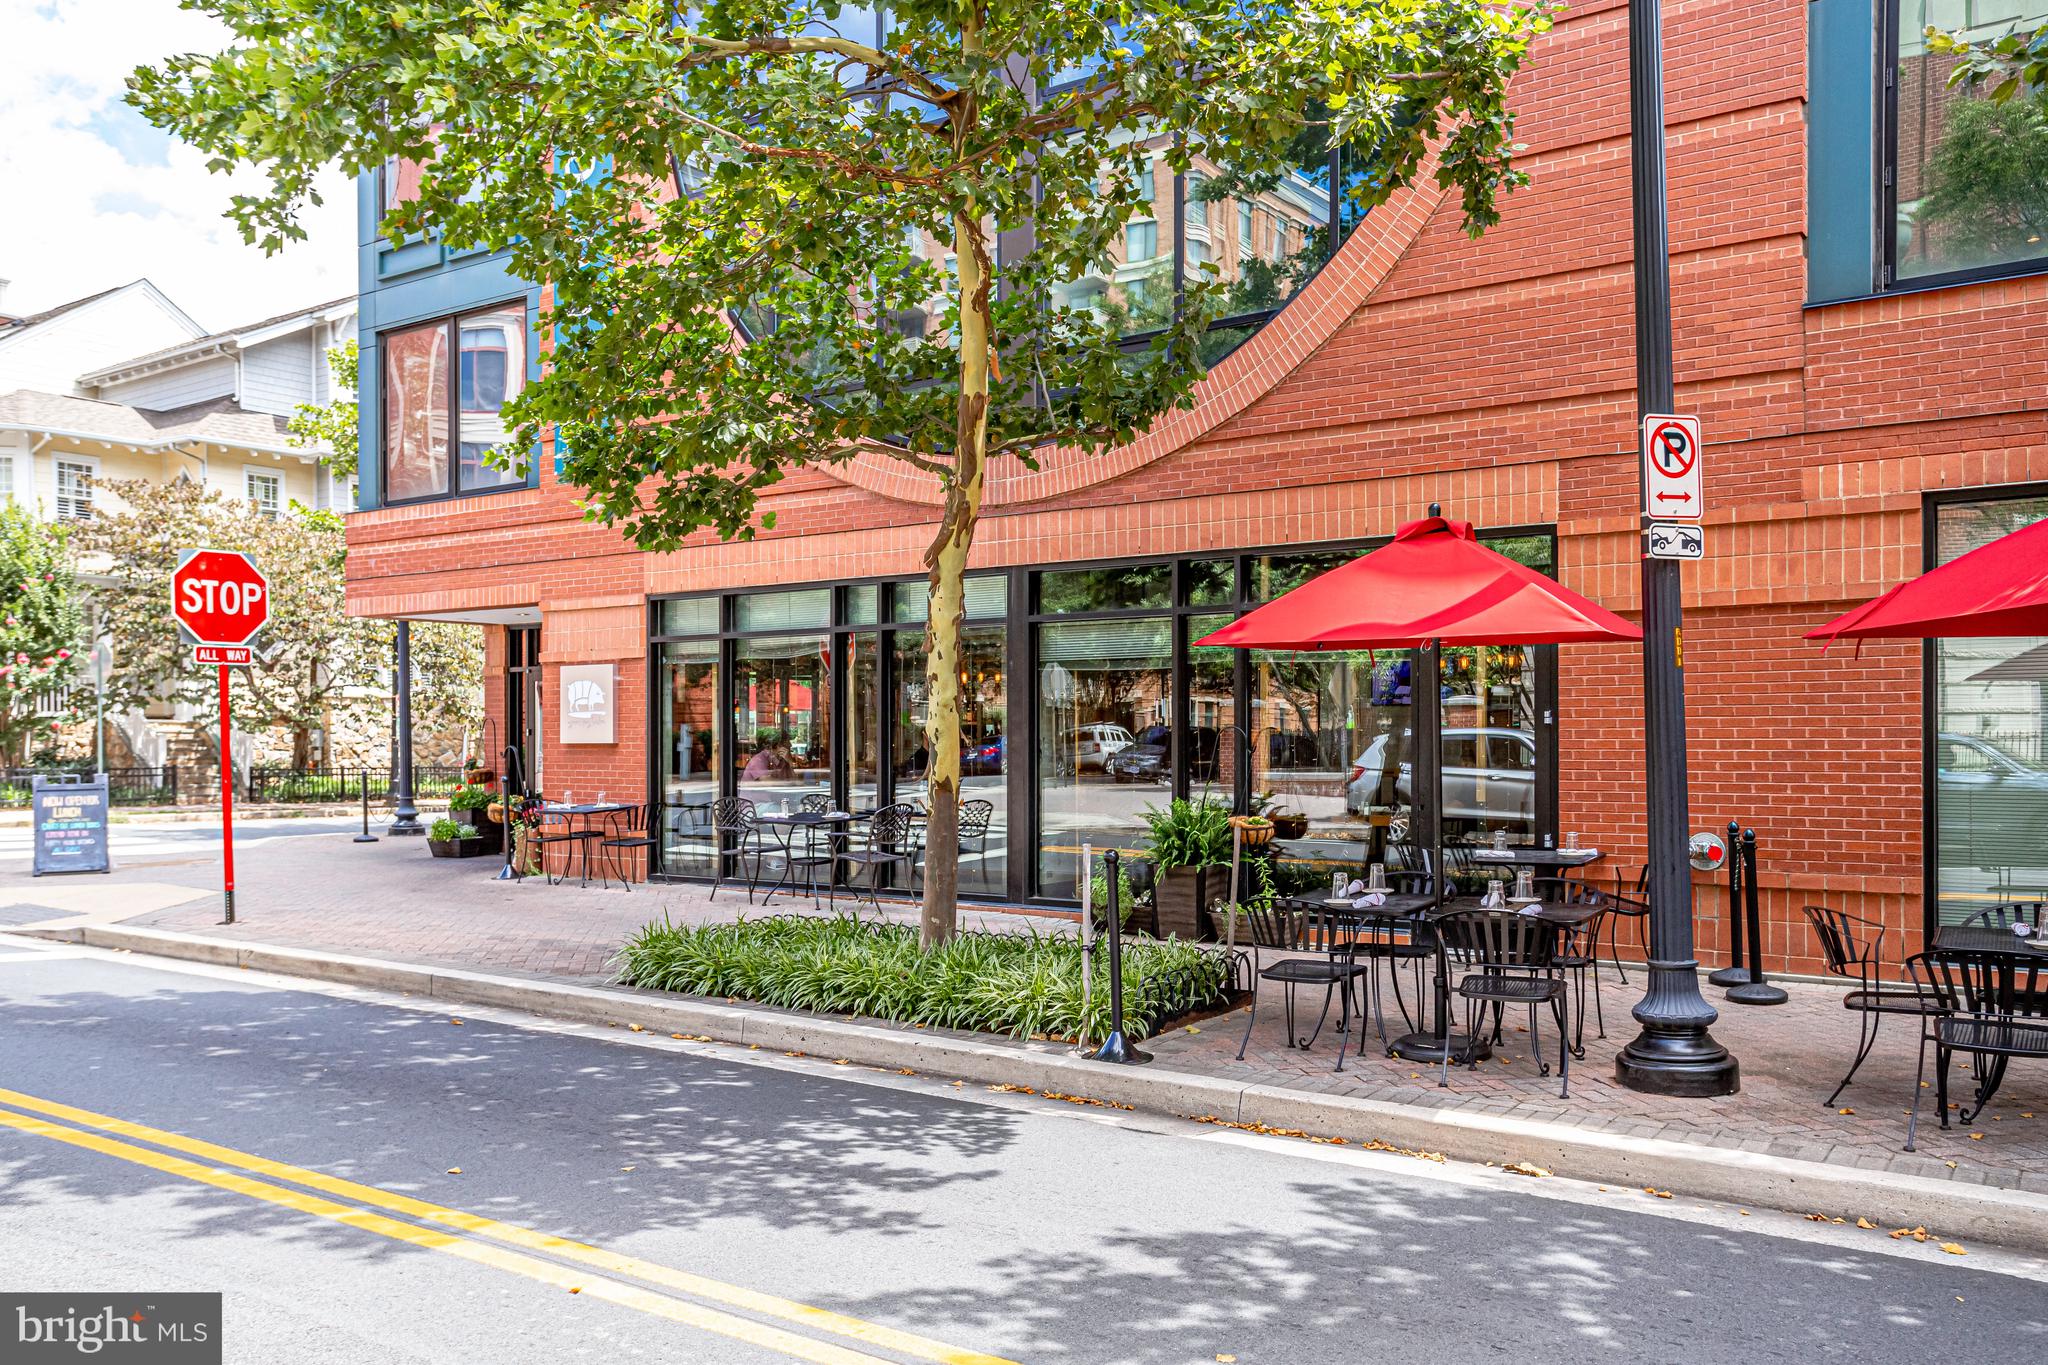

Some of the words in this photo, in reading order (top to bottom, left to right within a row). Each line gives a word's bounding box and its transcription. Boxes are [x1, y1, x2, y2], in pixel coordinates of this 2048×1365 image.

[1663, 431, 1687, 468] P
[181, 577, 263, 616] STOP
[199, 649, 220, 661] ALL
[226, 650, 248, 661] WAY
